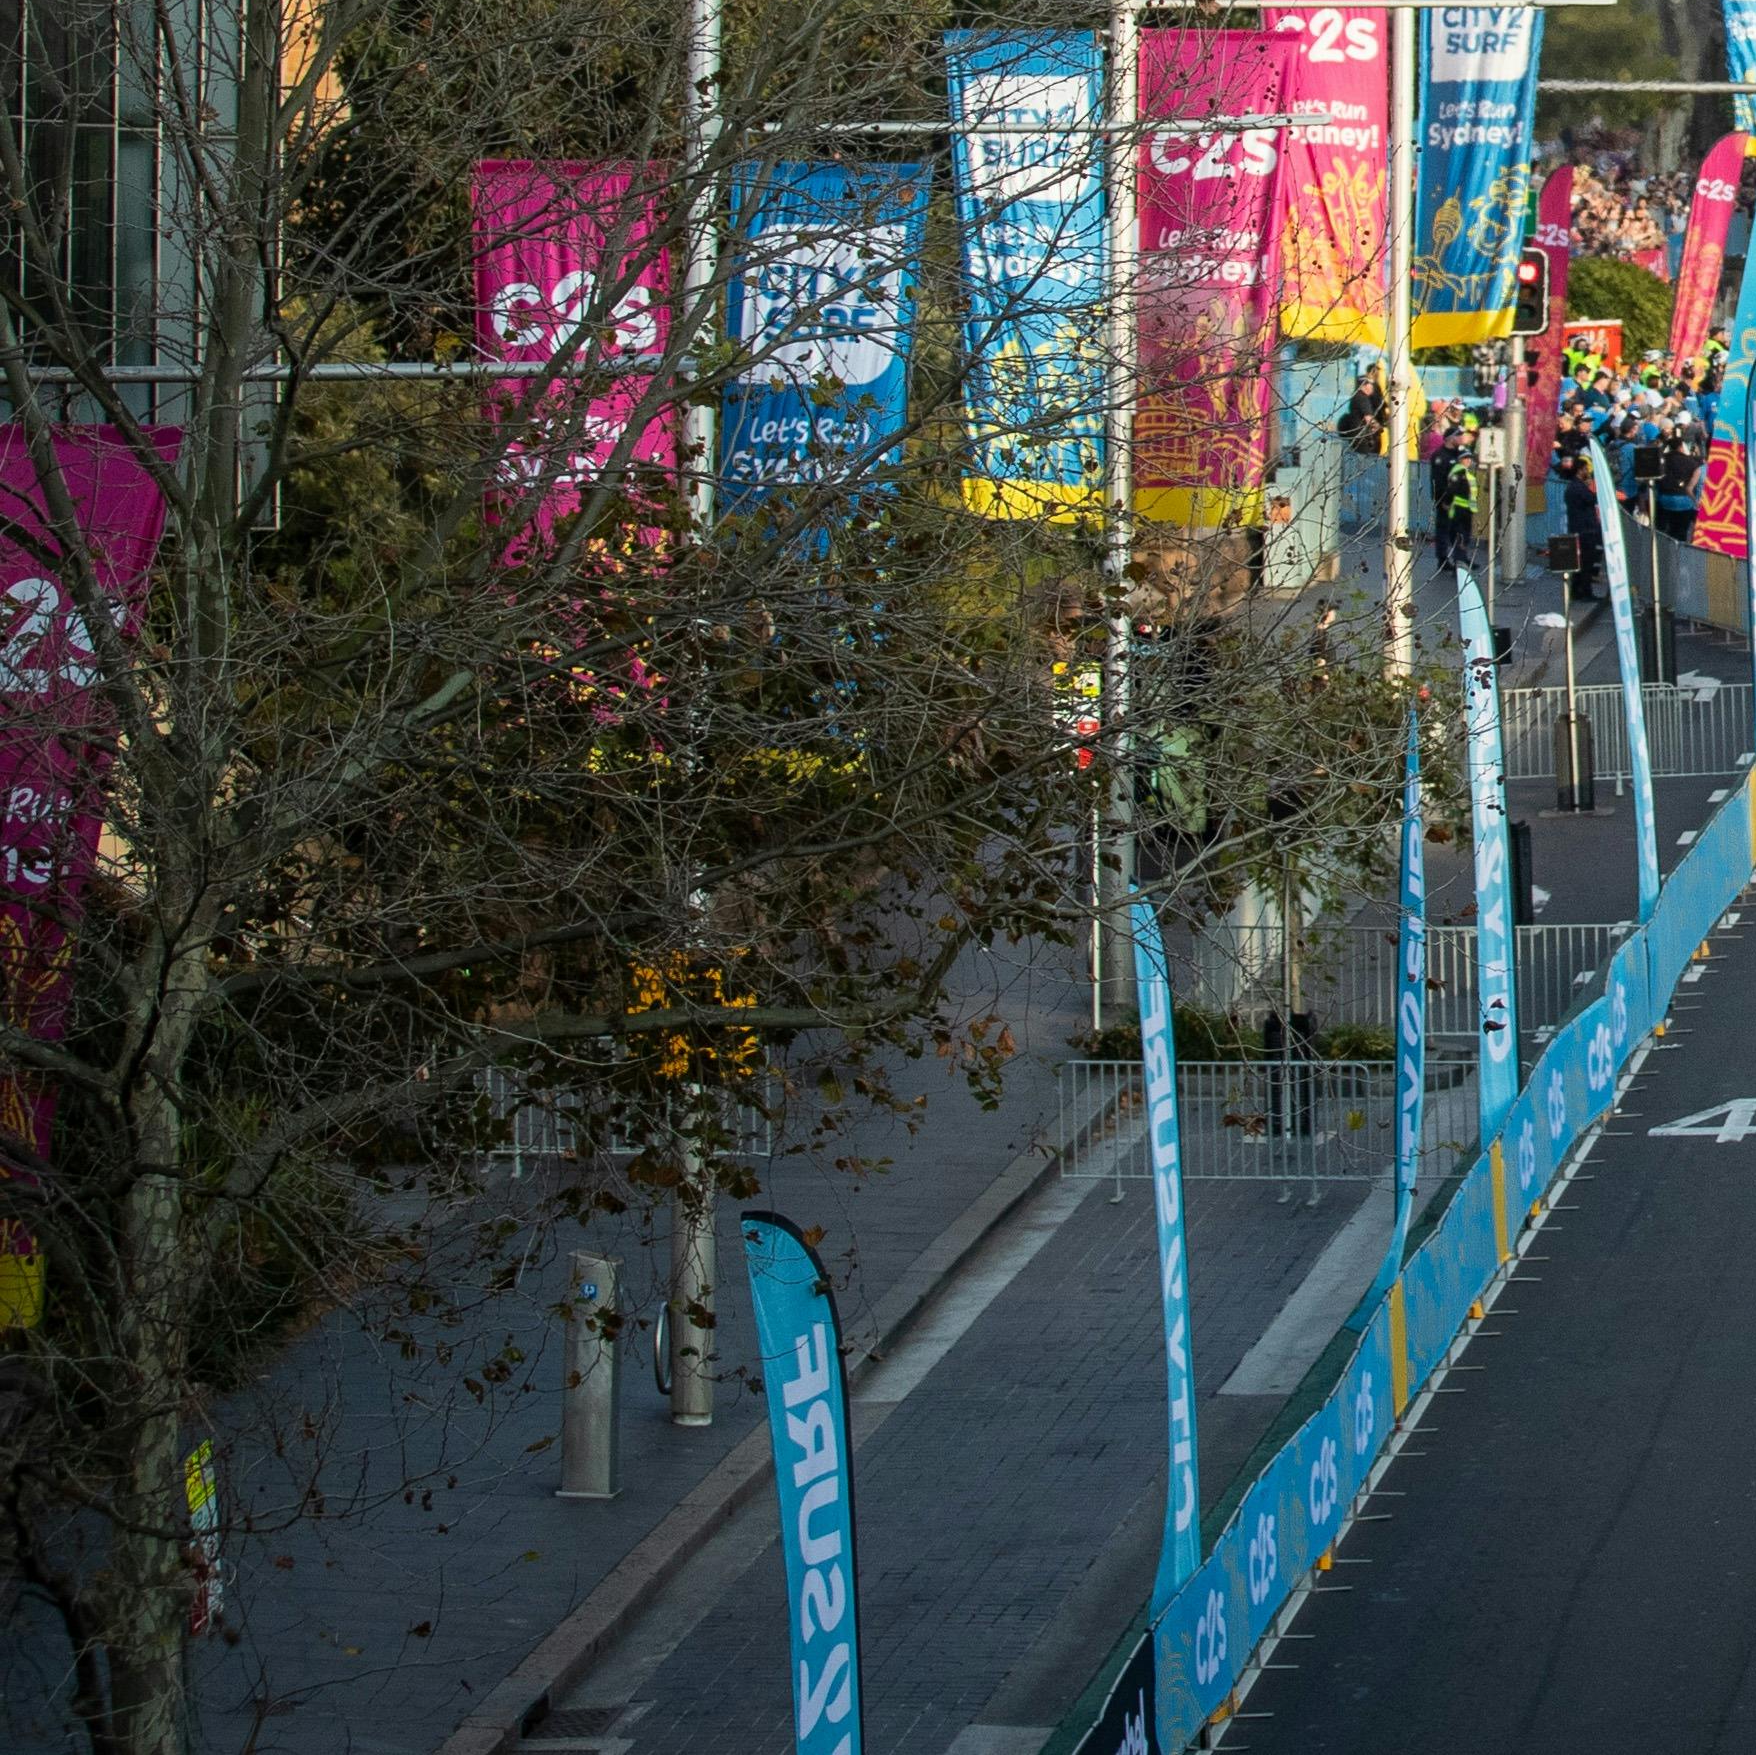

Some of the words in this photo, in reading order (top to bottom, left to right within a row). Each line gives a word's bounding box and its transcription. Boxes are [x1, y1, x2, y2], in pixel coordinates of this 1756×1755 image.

[1443, 5, 1525, 29] CITY2
[1446, 30, 1519, 55] SURF
[1330, 99, 1368, 122] Run
[1477, 99, 1516, 119] Run
[1428, 122, 1524, 151] Sydney!
[751, 416, 809, 444] Let's
